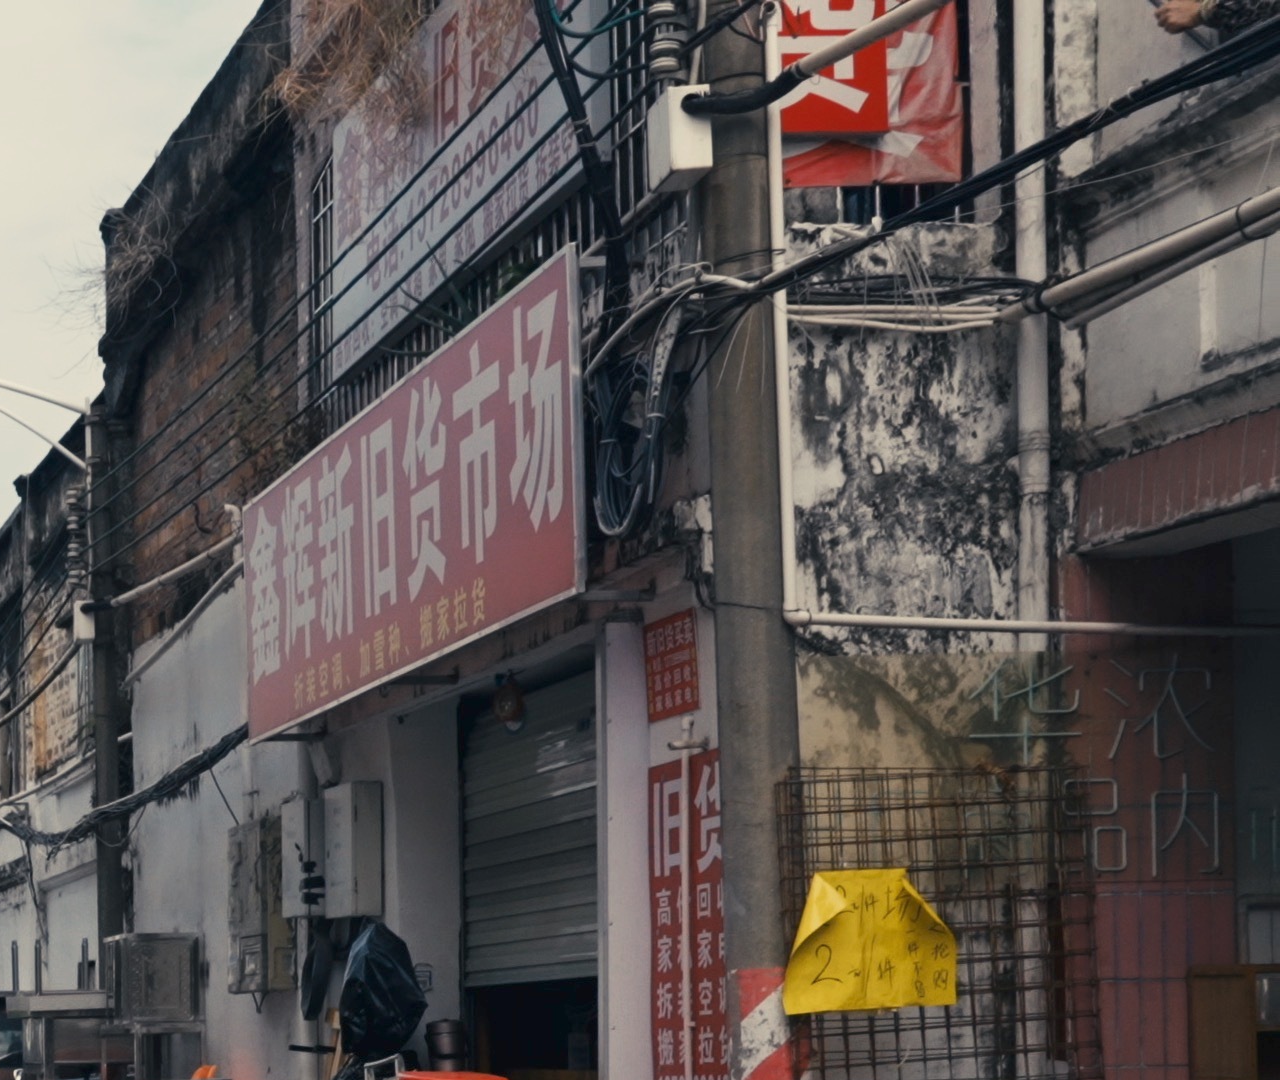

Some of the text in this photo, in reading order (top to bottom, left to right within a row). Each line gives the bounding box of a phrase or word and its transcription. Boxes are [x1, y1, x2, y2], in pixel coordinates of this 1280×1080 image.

[250, 290, 564, 687] 鑫辉新旧货市场
